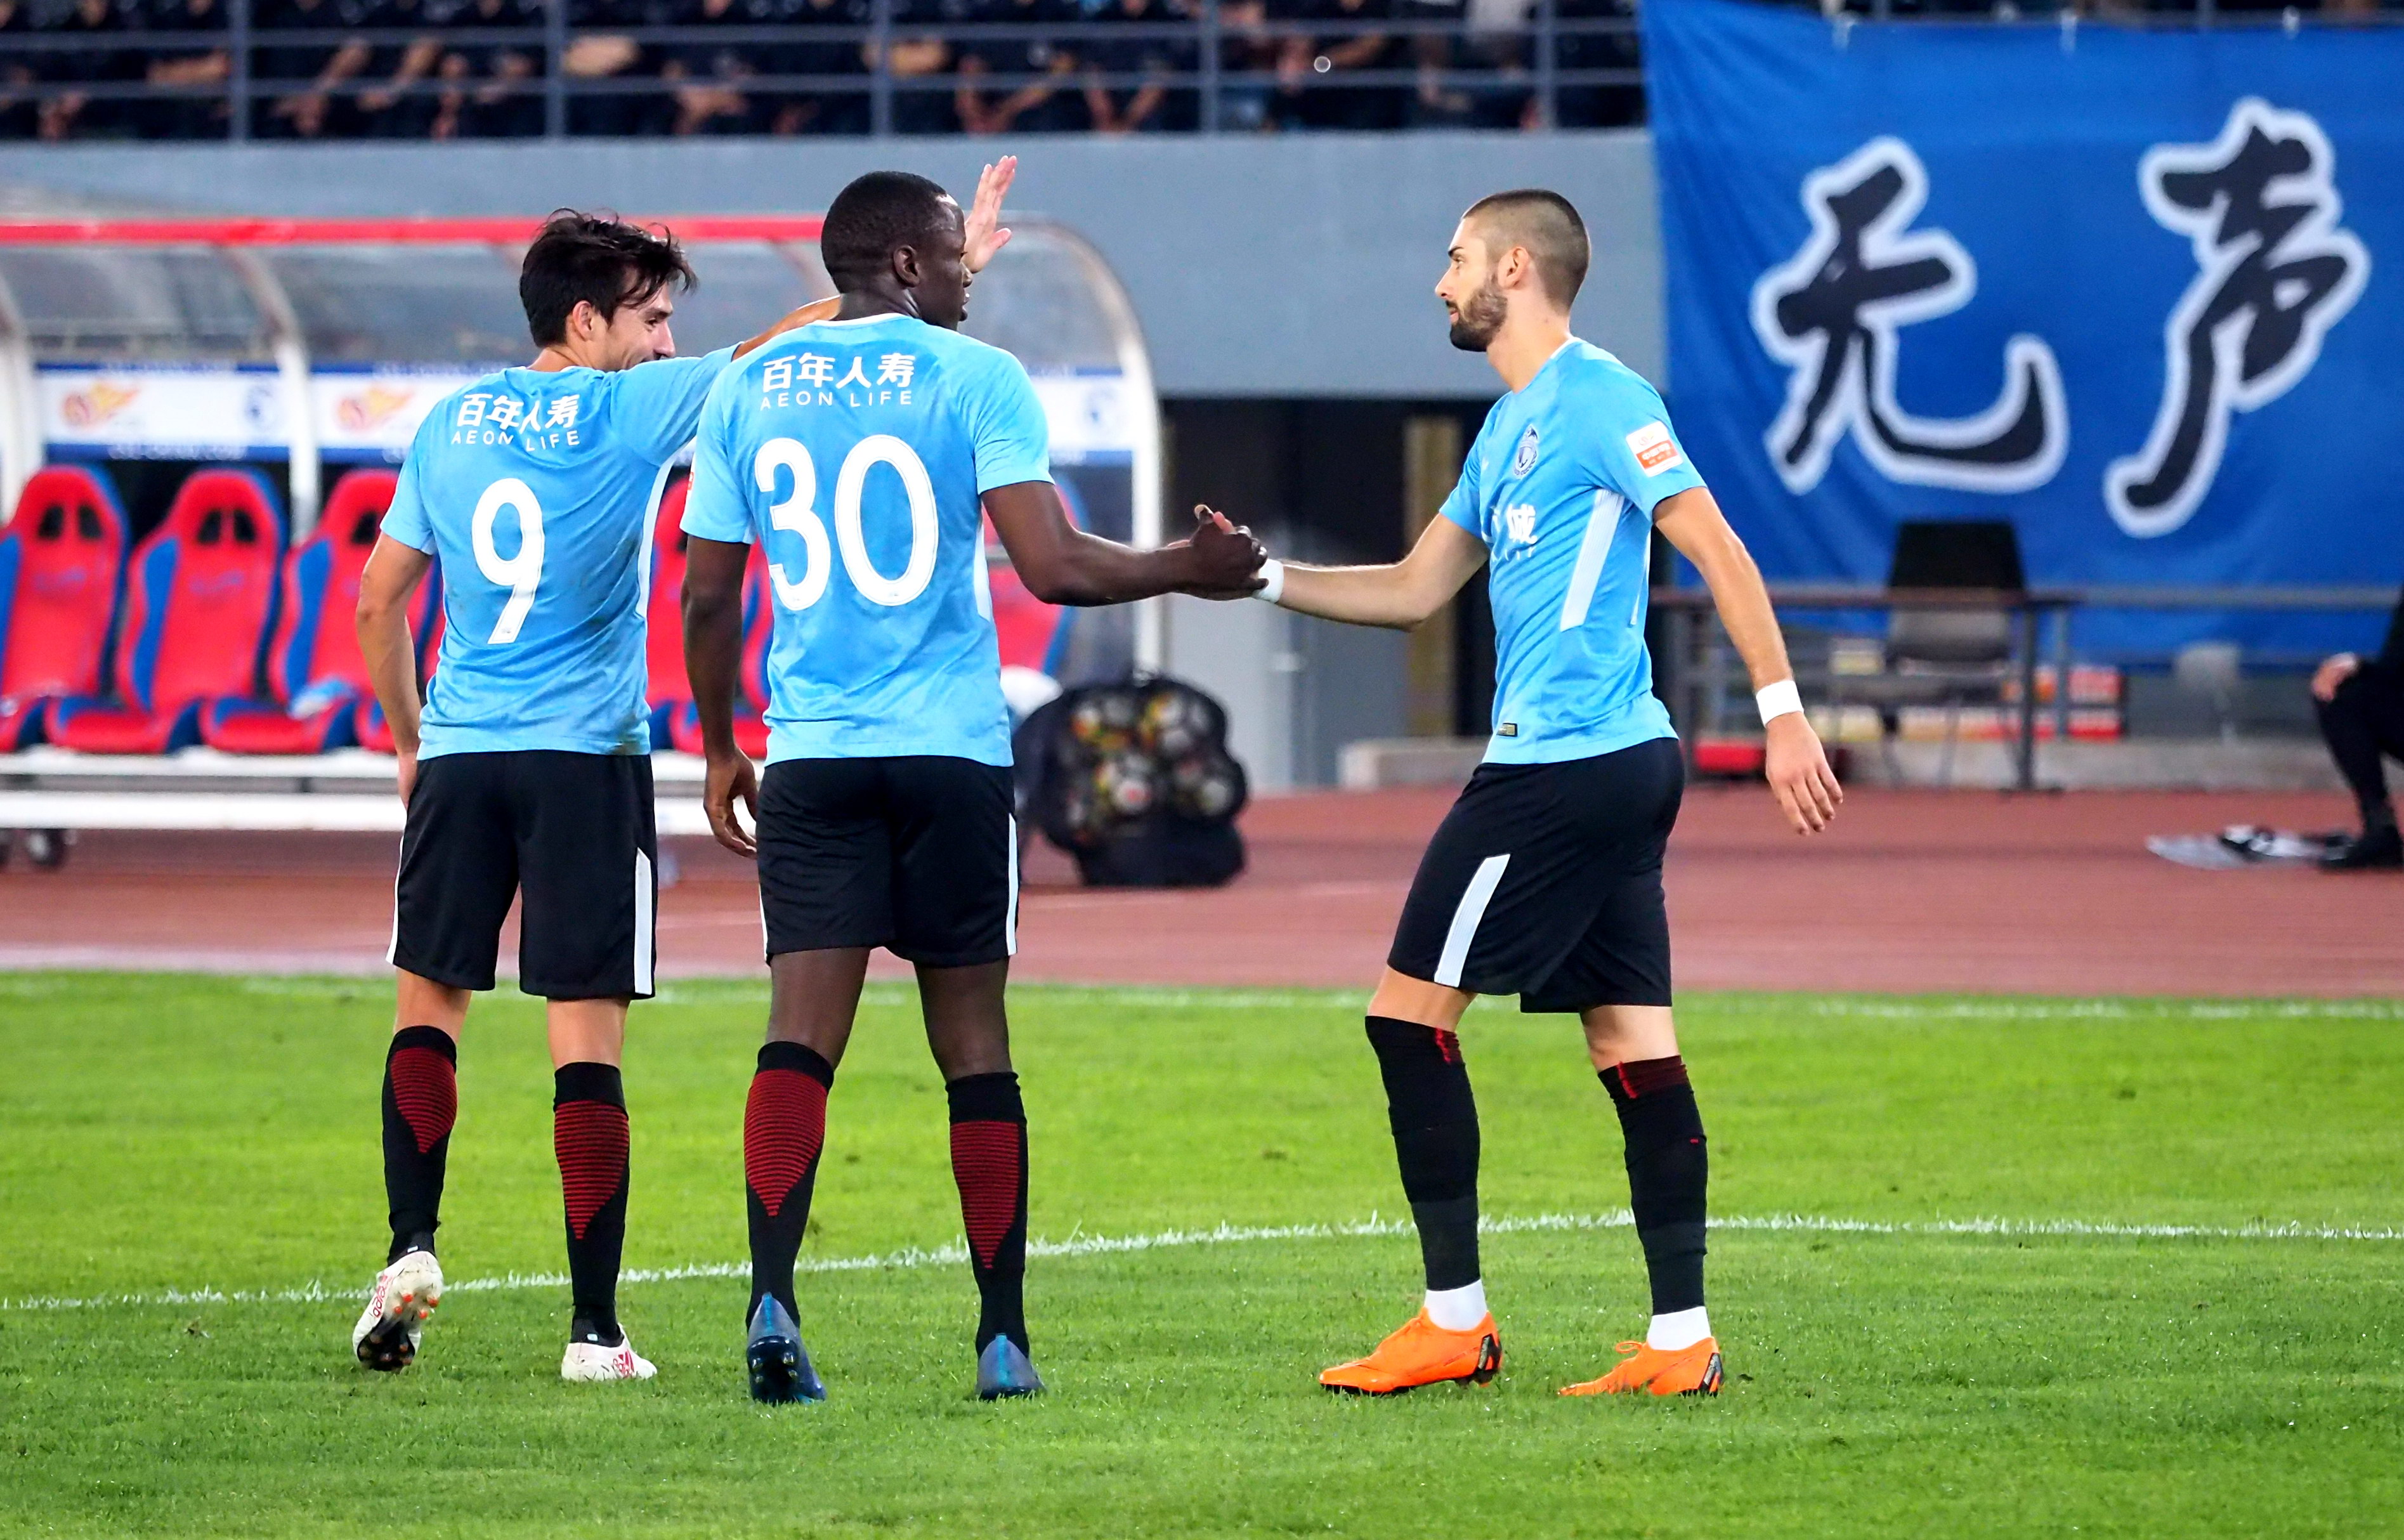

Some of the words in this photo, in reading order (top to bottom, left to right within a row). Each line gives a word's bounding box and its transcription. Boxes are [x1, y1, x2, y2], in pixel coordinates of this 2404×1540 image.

[762, 352, 915, 393] 百年人寿
[457, 393, 580, 434] 百年人寿
[760, 391, 833, 411] AEON
[850, 390, 911, 407] LIFE
[451, 430, 514, 445] AEON
[526, 430, 580, 452] LIFE
[754, 434, 939, 610] 30
[472, 478, 544, 644] 9
